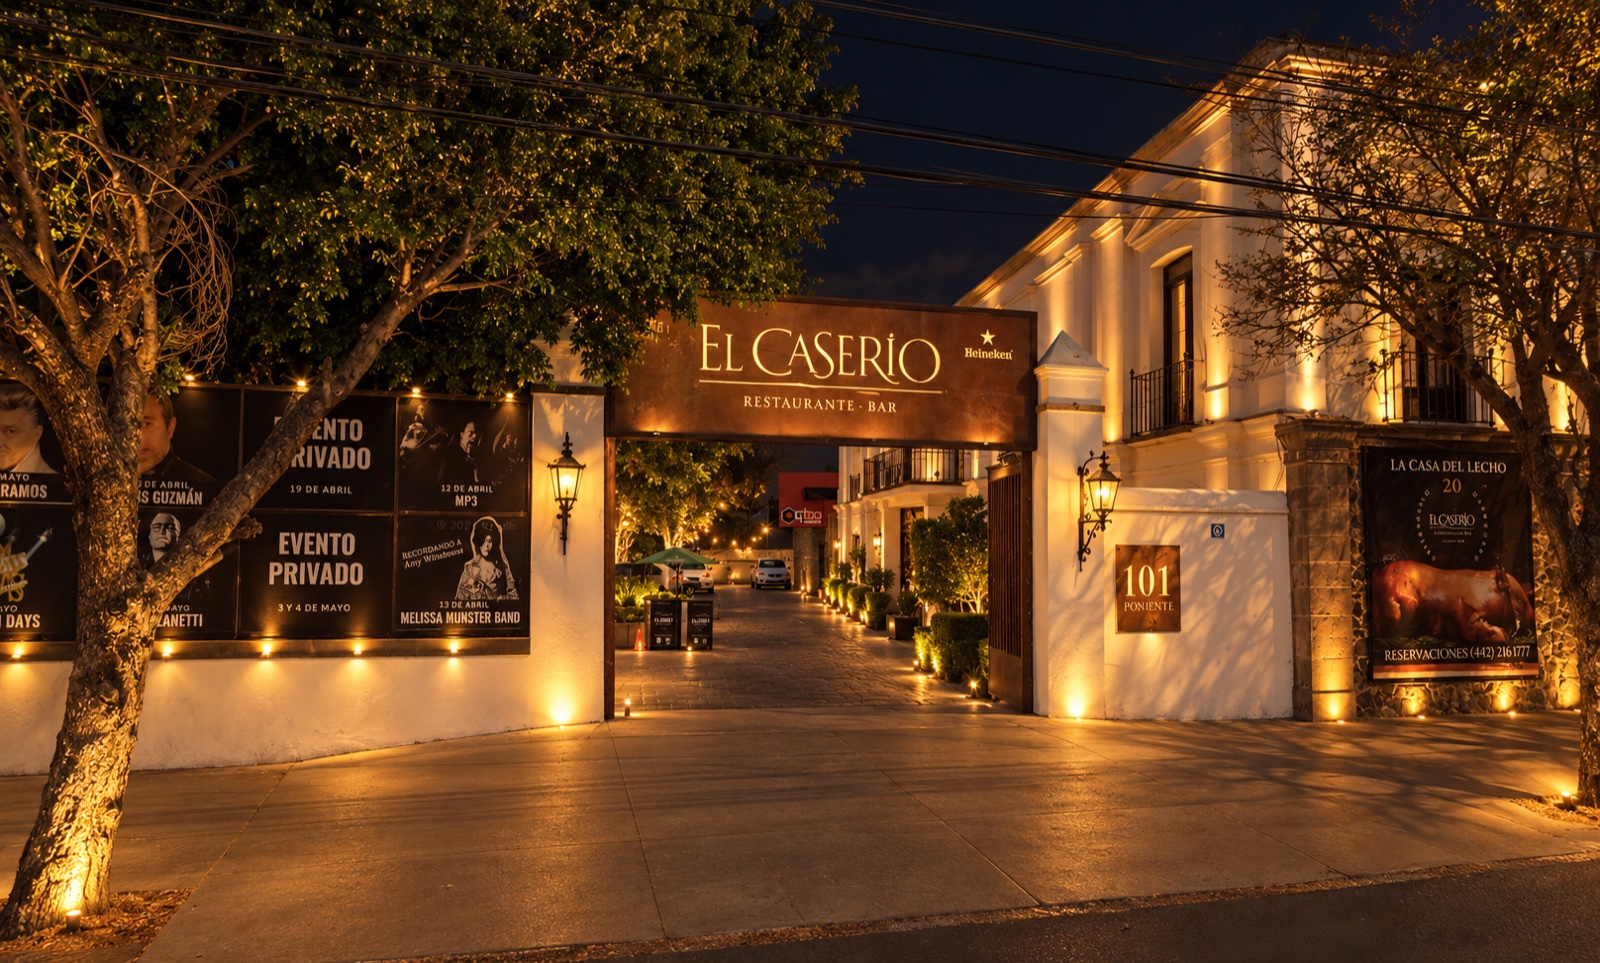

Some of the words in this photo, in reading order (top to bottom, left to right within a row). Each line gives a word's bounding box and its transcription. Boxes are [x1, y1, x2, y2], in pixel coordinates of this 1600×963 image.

[700, 324, 743, 371] EL
[964, 347, 1012, 360] Heineken
[743, 395, 855, 412] RESTAURANTE
[868, 401, 897, 413] BAR
[291, 445, 371, 470] RIVADO
[1390, 458, 1406, 472] LA
[1409, 459, 1440, 472] CASA
[1442, 460, 1464, 473] DEL
[1467, 461, 1507, 474] LECHO
[0, 483, 48, 499] RAMOS
[144, 480, 157, 489] DE
[160, 481, 190, 489] ABRIL
[290, 484, 302, 493] 19
[305, 485, 319, 494] DE
[322, 486, 353, 495] ABRIL
[441, 484, 451, 493] 12
[453, 485, 465, 493] DE
[468, 485, 494, 493] ABRIL
[1442, 478, 1462, 493] 20
[152, 487, 203, 505] GUZMÁN
[455, 495, 478, 507] MP3
[278, 532, 355, 556] EVENTO
[402, 540, 455, 560] RECORDANDO
[268, 562, 364, 585] PRIVADO
[1124, 564, 1170, 597] 101
[277, 604, 284, 612] 3
[286, 604, 293, 612] Y
[295, 604, 301, 612] 4
[304, 604, 318, 612] DE
[321, 604, 351, 612] MAYO
[451, 601, 463, 609] DE
[465, 601, 490, 609] ABRIL
[1124, 601, 1174, 612] PONIENTE
[6, 613, 41, 628] DAYS
[400, 611, 443, 624] MELISSA
[445, 611, 491, 624] MUNSTER
[494, 611, 521, 624] BAND
[1384, 647, 1468, 661] RESERVACIONES
[1470, 646, 1495, 660] (442)
